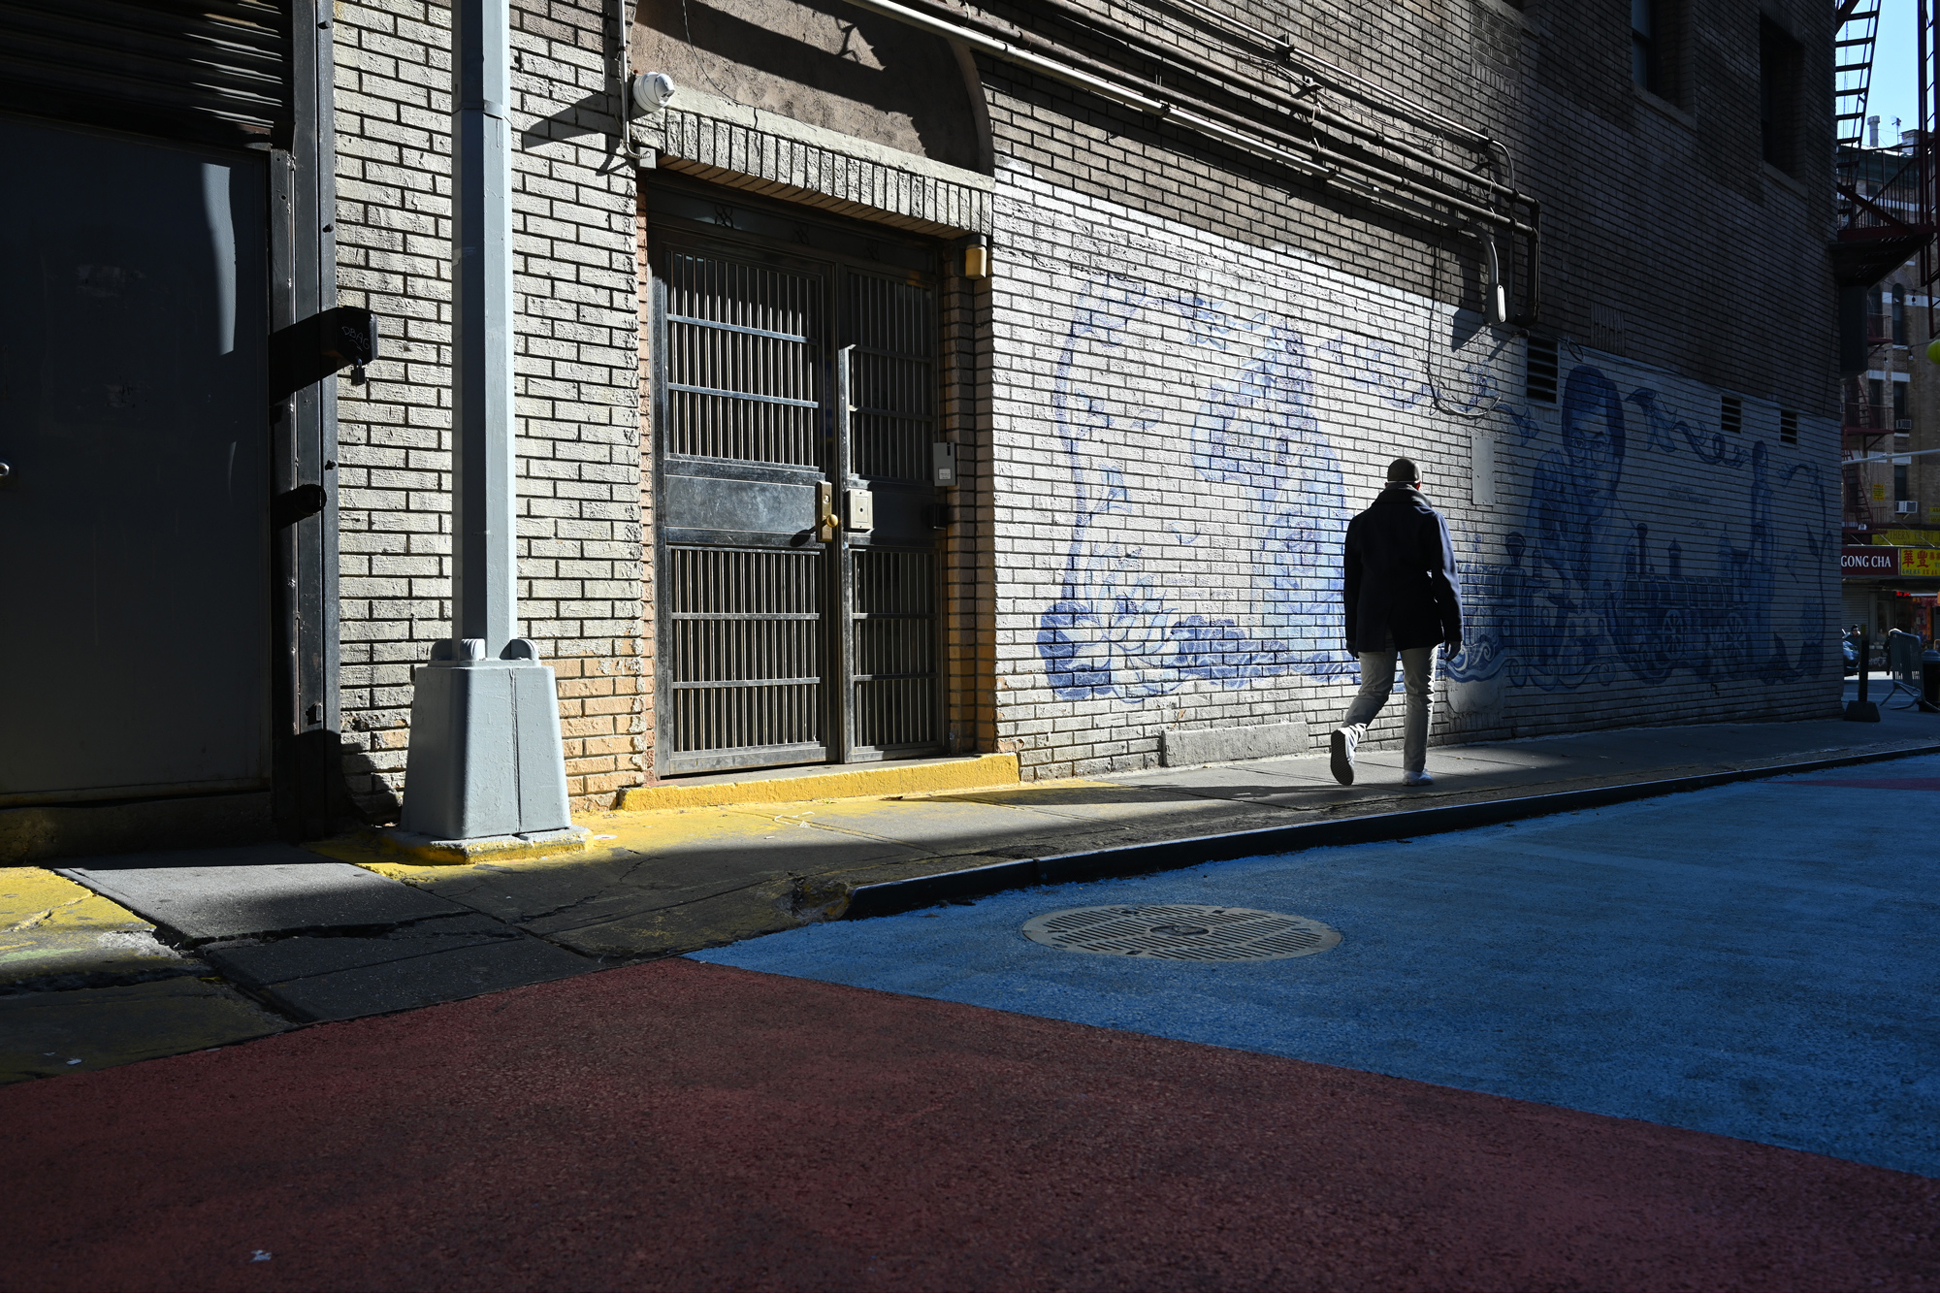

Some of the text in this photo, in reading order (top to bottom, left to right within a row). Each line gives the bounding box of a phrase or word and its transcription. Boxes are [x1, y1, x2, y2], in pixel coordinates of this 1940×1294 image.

[341, 325, 370, 350] DBAG
[1841, 555, 1892, 568] GONG CHA
